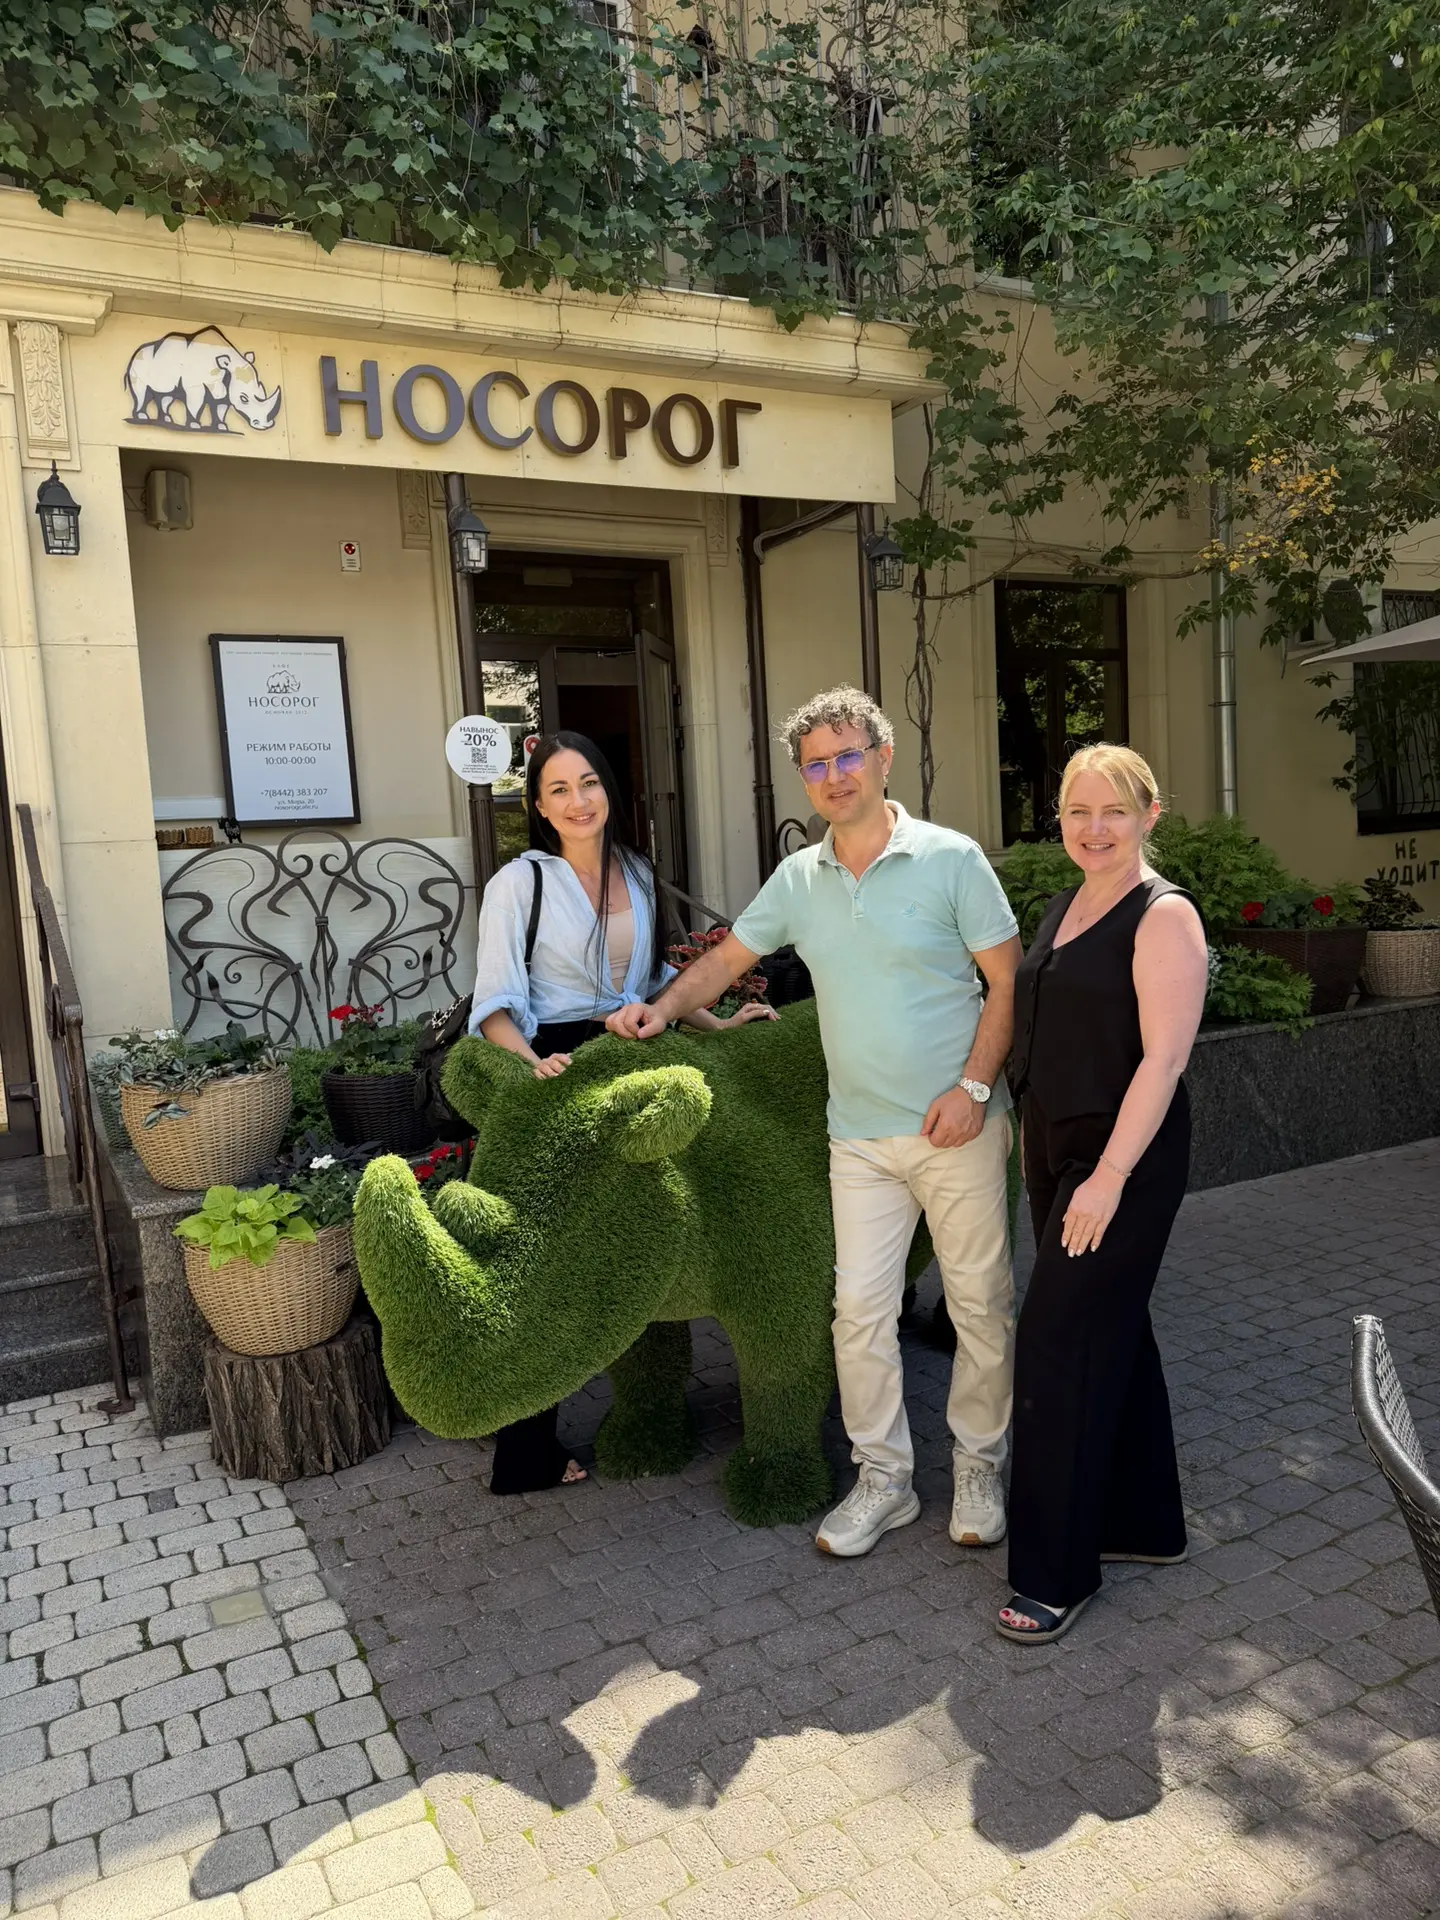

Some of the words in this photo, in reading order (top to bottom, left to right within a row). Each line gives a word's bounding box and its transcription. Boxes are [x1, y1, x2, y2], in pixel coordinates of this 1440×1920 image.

[319, 355, 763, 470] НОСОРОГ
[248, 696, 320, 708] НОСОРОГ
[459, 726, 499, 734] НАВЫНОС
[463, 733, 497, 747] 20%
[246, 743, 286, 752] РЕЖИМ
[289, 742, 331, 751] РАБОТЫ
[265, 756, 316, 765] 10:00-00:00
[260, 789, 294, 799] +7(8442)
[296, 788, 312, 796] 383
[313, 788, 328, 796] 207
[1395, 837, 1417, 860] НЕ
